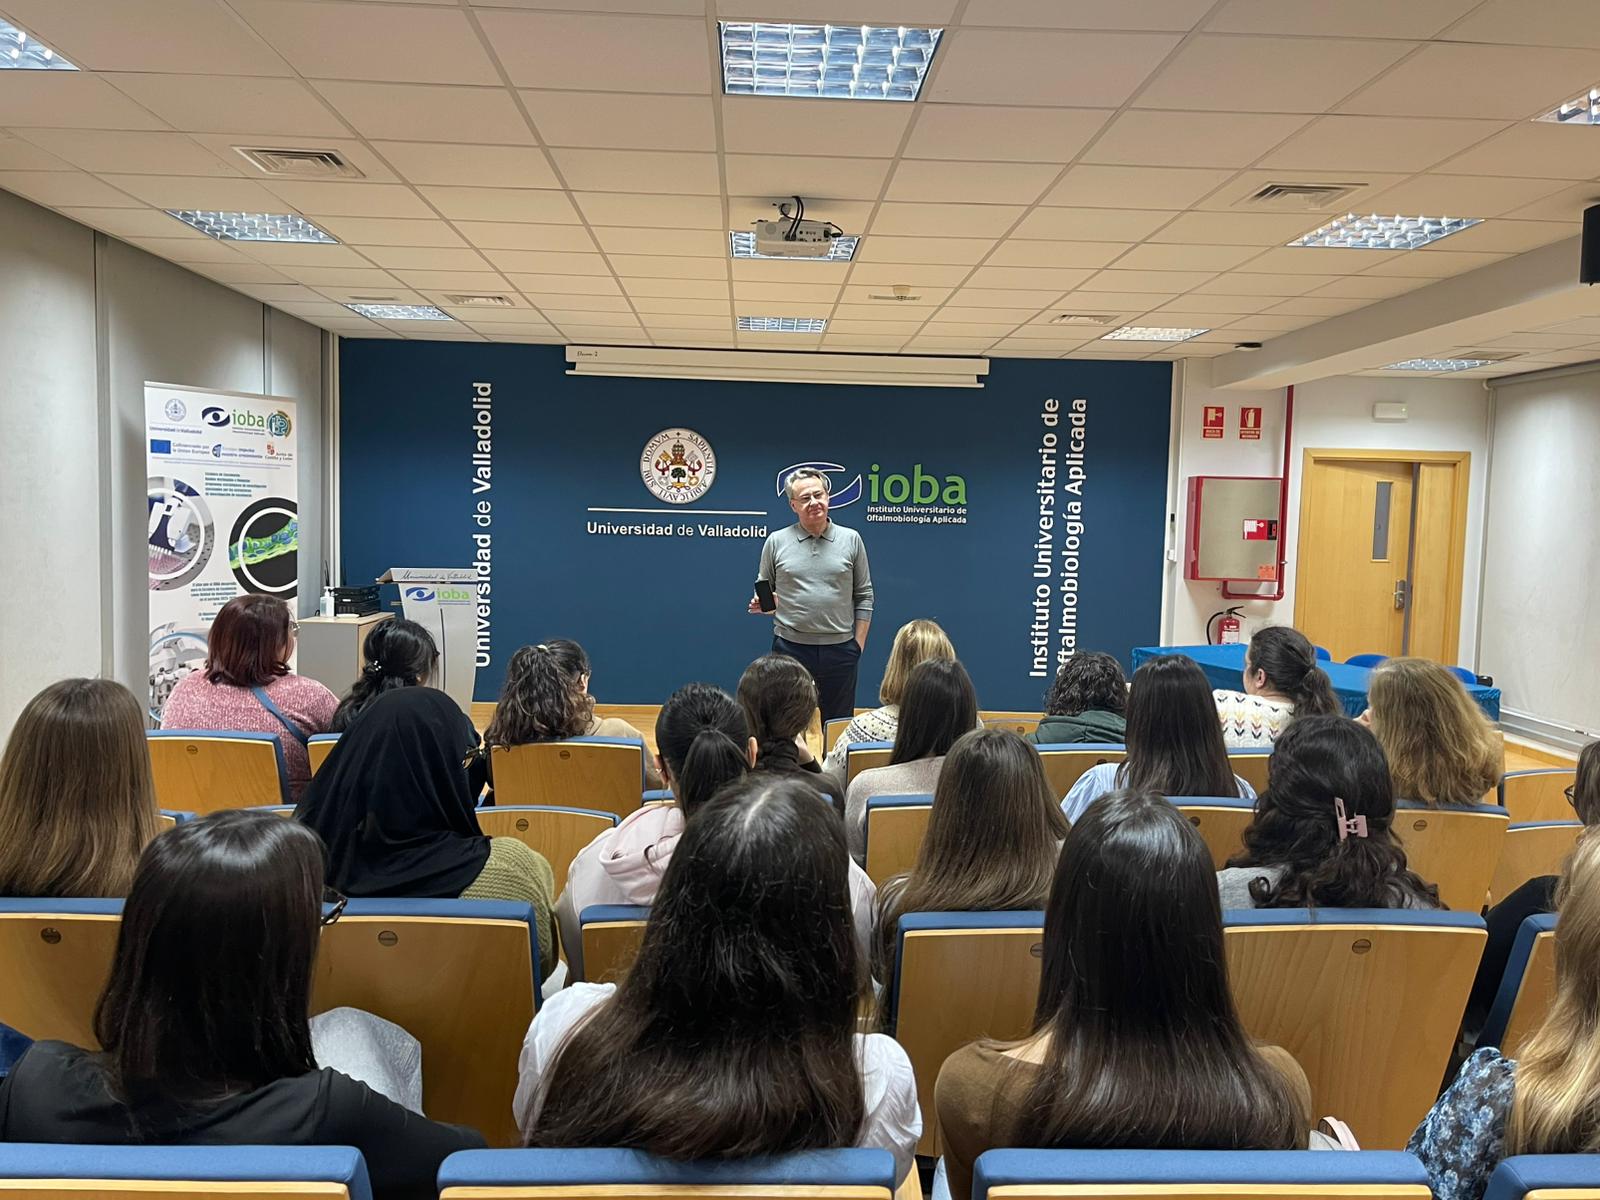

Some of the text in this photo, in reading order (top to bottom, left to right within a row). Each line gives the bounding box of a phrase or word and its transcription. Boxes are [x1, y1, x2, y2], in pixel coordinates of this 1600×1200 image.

[232, 409, 265, 428] ioba
[643, 433, 670, 463] DOMVM
[1064, 399, 1087, 496] Aplicada
[868, 463, 967, 505] ioba
[866, 514, 967, 525] Oftalmobiología Aplicada
[867, 505, 967, 515] Instituto Universitario de
[472, 382, 492, 668] Universidad de Valladolid
[587, 521, 768, 538] Universidad de Valladolid
[1029, 398, 1060, 677] Instituto Universitario de
[437, 588, 470, 600] ioba
